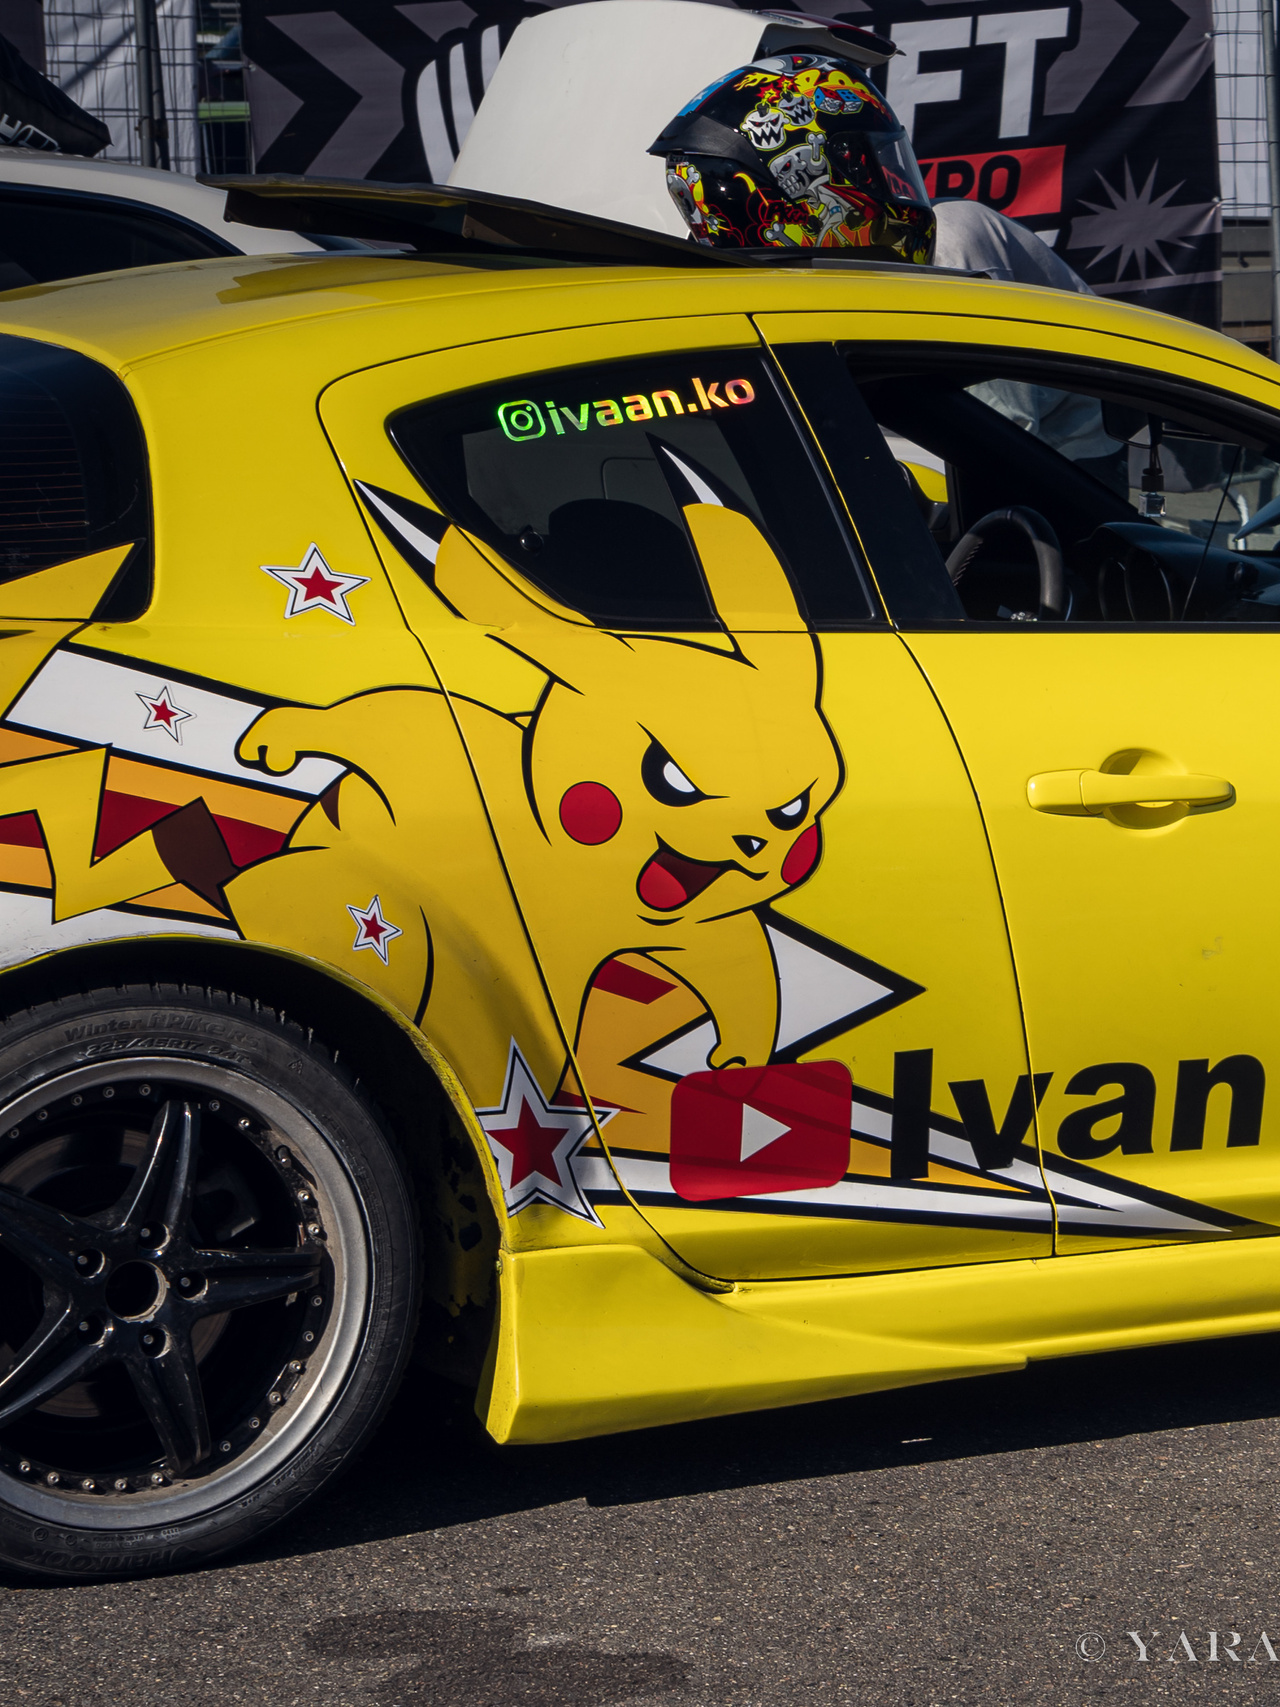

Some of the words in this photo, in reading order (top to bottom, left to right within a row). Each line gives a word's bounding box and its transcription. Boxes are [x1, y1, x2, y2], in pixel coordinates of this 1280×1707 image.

[547, 377, 755, 435] ivaan.ko
[64, 1017, 142, 1042] Winter
[889, 1047, 1267, 1180] Ivan
